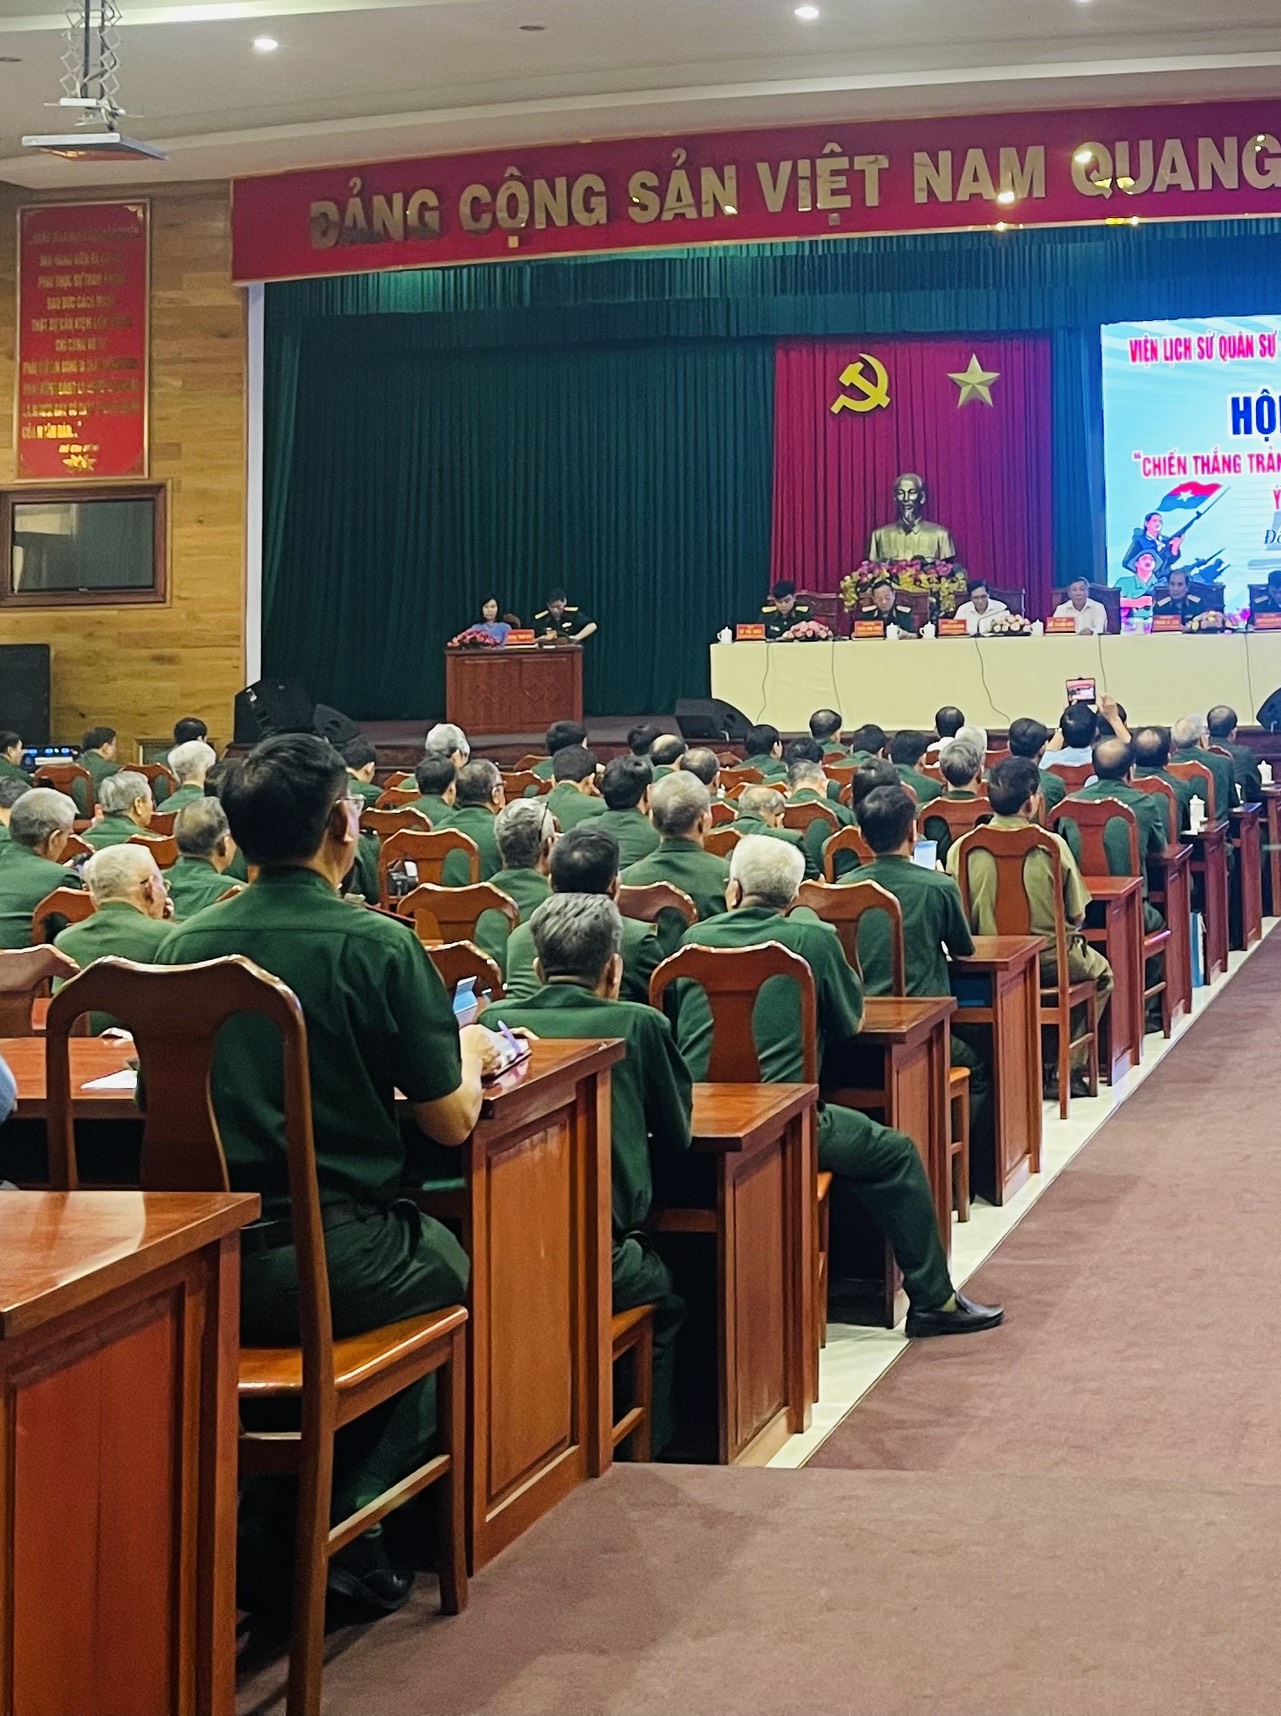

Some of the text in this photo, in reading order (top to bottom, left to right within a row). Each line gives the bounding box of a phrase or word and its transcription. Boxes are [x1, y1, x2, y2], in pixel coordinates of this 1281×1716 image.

[310, 178, 441, 250] ĐẢNG
[460, 167, 608, 248] CỘNG
[629, 148, 738, 223] SẢN
[757, 142, 889, 226] VIỆT
[914, 145, 1046, 204] NAM
[1164, 337, 1193, 366] LỊCH
[1219, 331, 1254, 361] QUÂN
[1193, 447, 1241, 475] THẮNG
[1273, 485, 1281, 510] Ý
